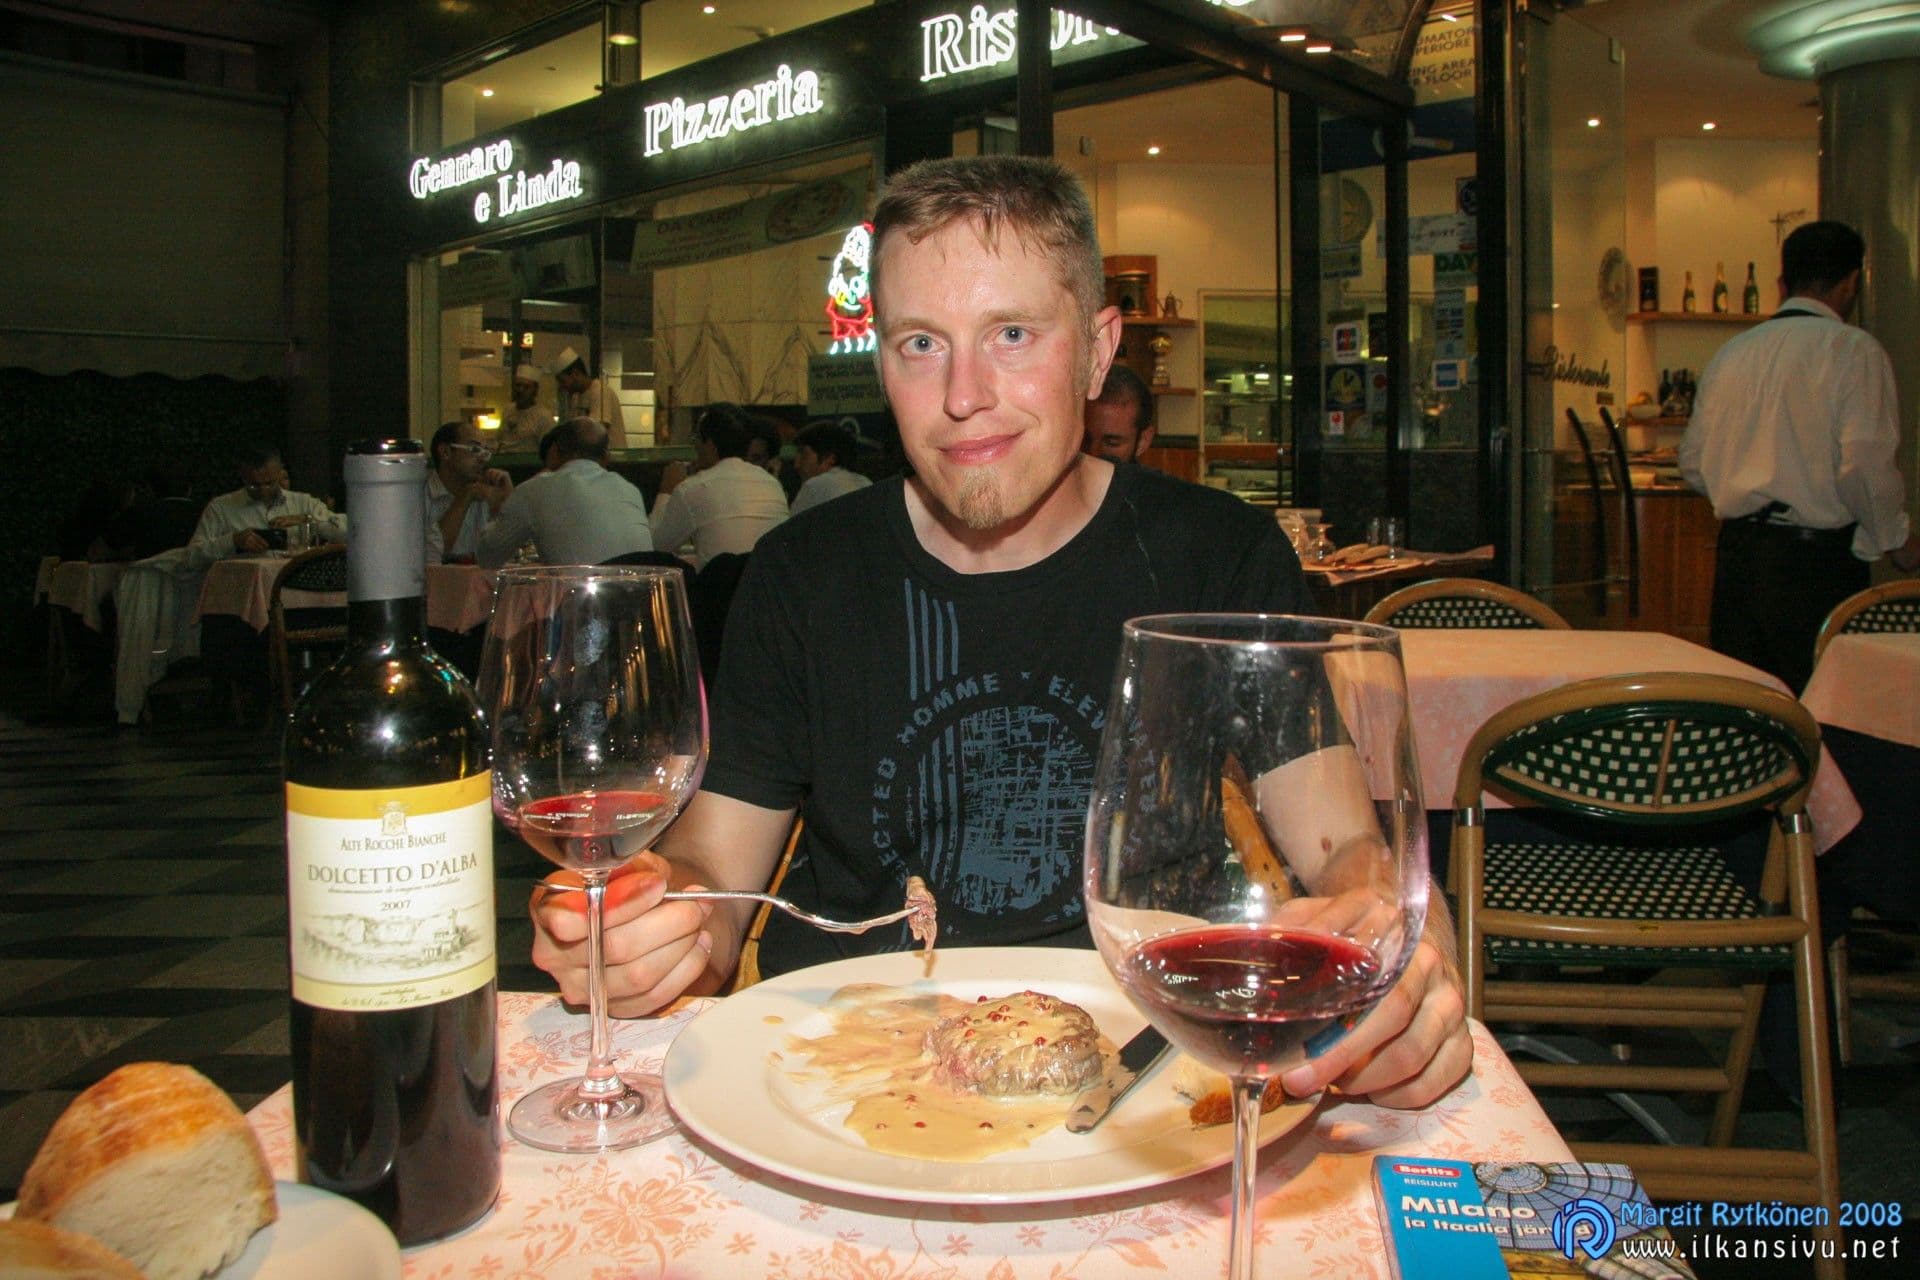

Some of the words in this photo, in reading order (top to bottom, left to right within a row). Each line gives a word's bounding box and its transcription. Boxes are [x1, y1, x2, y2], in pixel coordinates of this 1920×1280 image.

[643, 64, 823, 157] Pizzeria
[410, 139, 514, 199] Gennaro
[474, 192, 491, 223] e
[498, 159, 584, 218] Linda
[340, 837, 362, 851] ALTE
[365, 837, 404, 851] ROCCHE
[407, 832, 447, 848] BIANCHE
[307, 863, 413, 885] DOLCETTO
[420, 853, 478, 880] D'ALBA
[381, 899, 412, 912] 2007
[1399, 1165, 1455, 1177] Berlitz
[1401, 1196, 1537, 1220] Milano
[1403, 1216, 1427, 1230] ja
[1434, 1218, 1510, 1236] Itaalia
